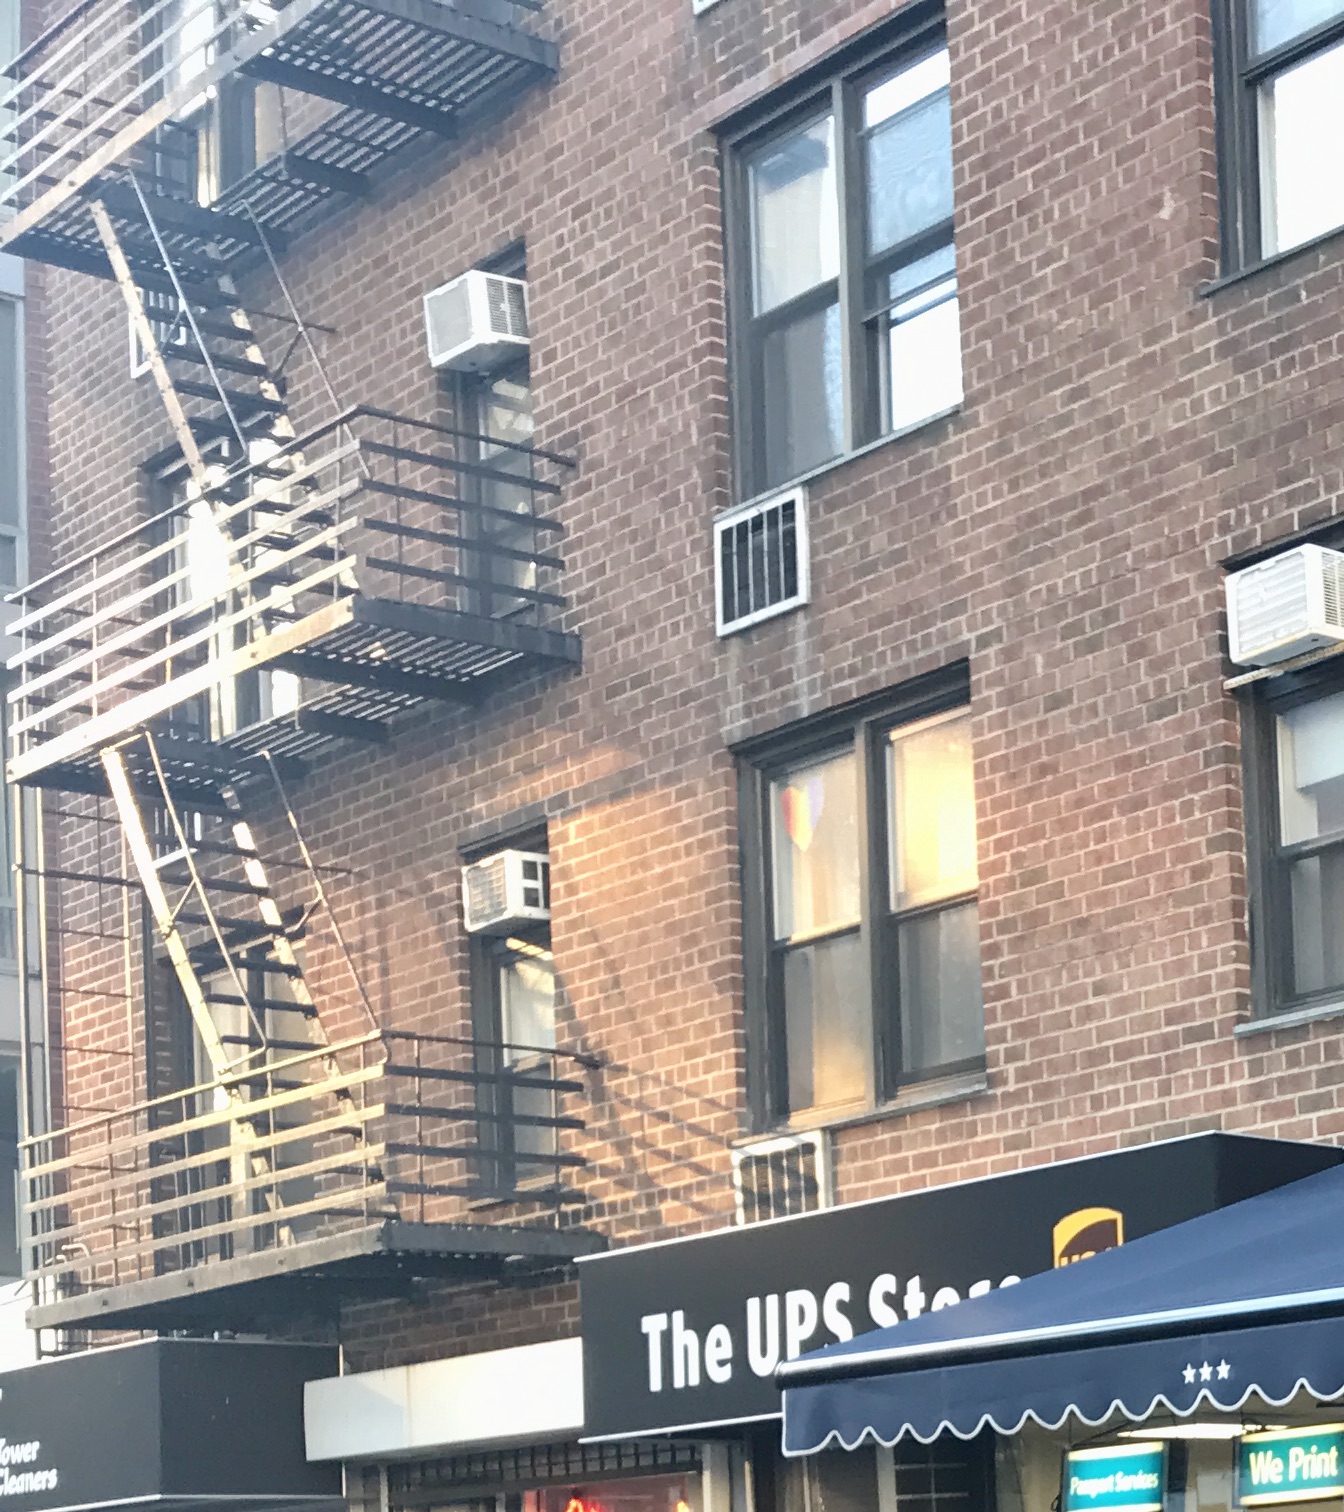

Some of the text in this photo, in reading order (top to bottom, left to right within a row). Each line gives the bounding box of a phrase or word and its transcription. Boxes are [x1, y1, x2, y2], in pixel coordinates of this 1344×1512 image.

[641, 1273, 1021, 1392] The UPS Sto
[1250, 1445, 1339, 1485] We Print
